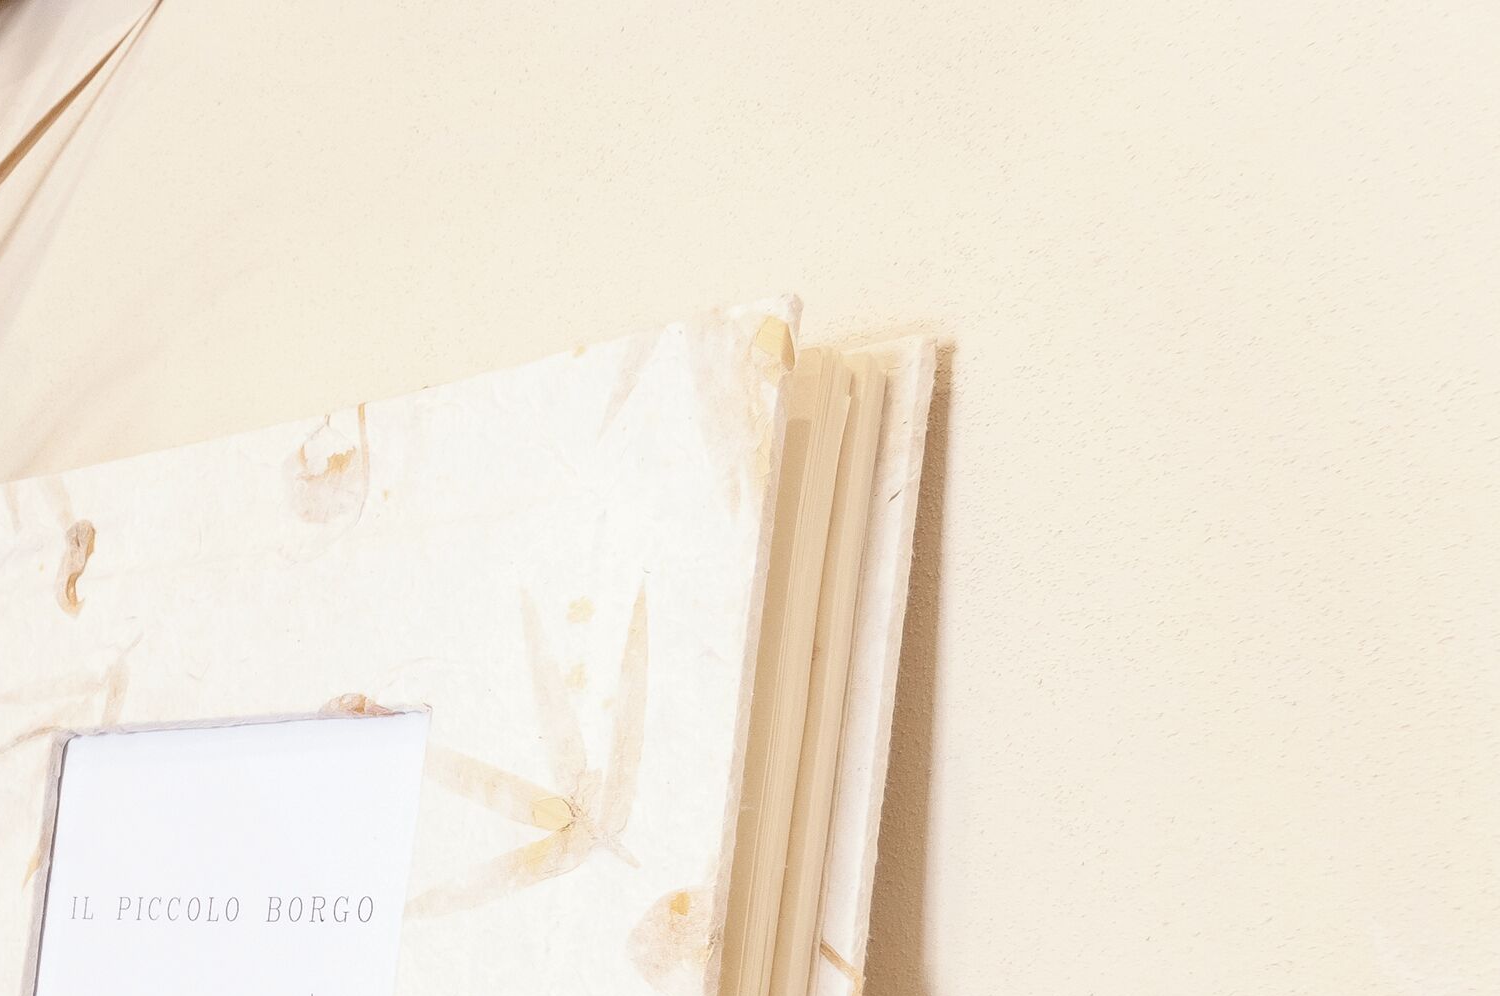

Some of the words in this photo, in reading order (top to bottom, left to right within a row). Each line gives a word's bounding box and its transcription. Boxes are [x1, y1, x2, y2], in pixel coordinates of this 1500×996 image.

[70, 896, 94, 920] IL
[116, 896, 240, 923] PICCOLO
[266, 895, 375, 923] BORGO
